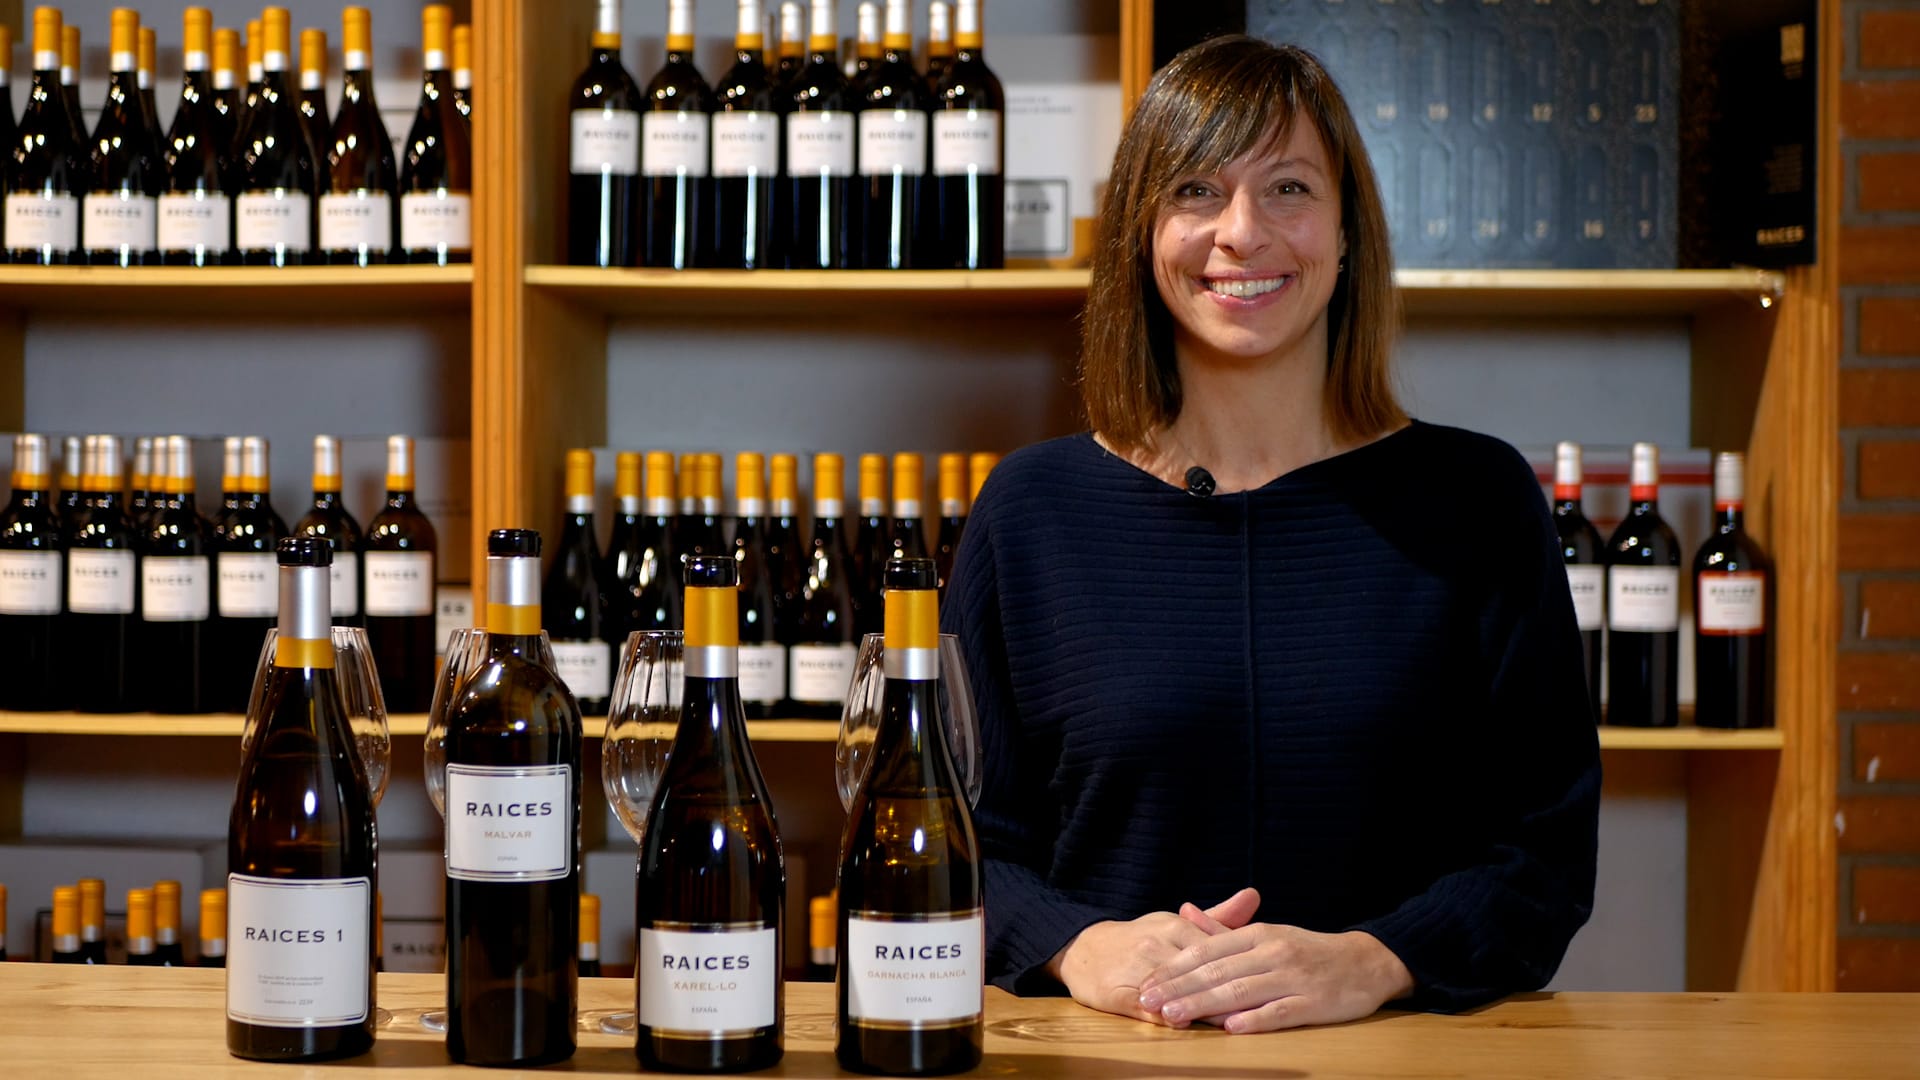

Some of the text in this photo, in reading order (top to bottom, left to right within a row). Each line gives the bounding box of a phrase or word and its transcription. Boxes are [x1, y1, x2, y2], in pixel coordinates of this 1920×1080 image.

[466, 802, 553, 817] RAICES
[484, 831, 532, 840] MALVAR
[245, 927, 345, 943] RAICES 1
[874, 944, 962, 960] RAICES
[662, 955, 751, 970] RAICES
[866, 970, 967, 981] GARNACHA BLANCA
